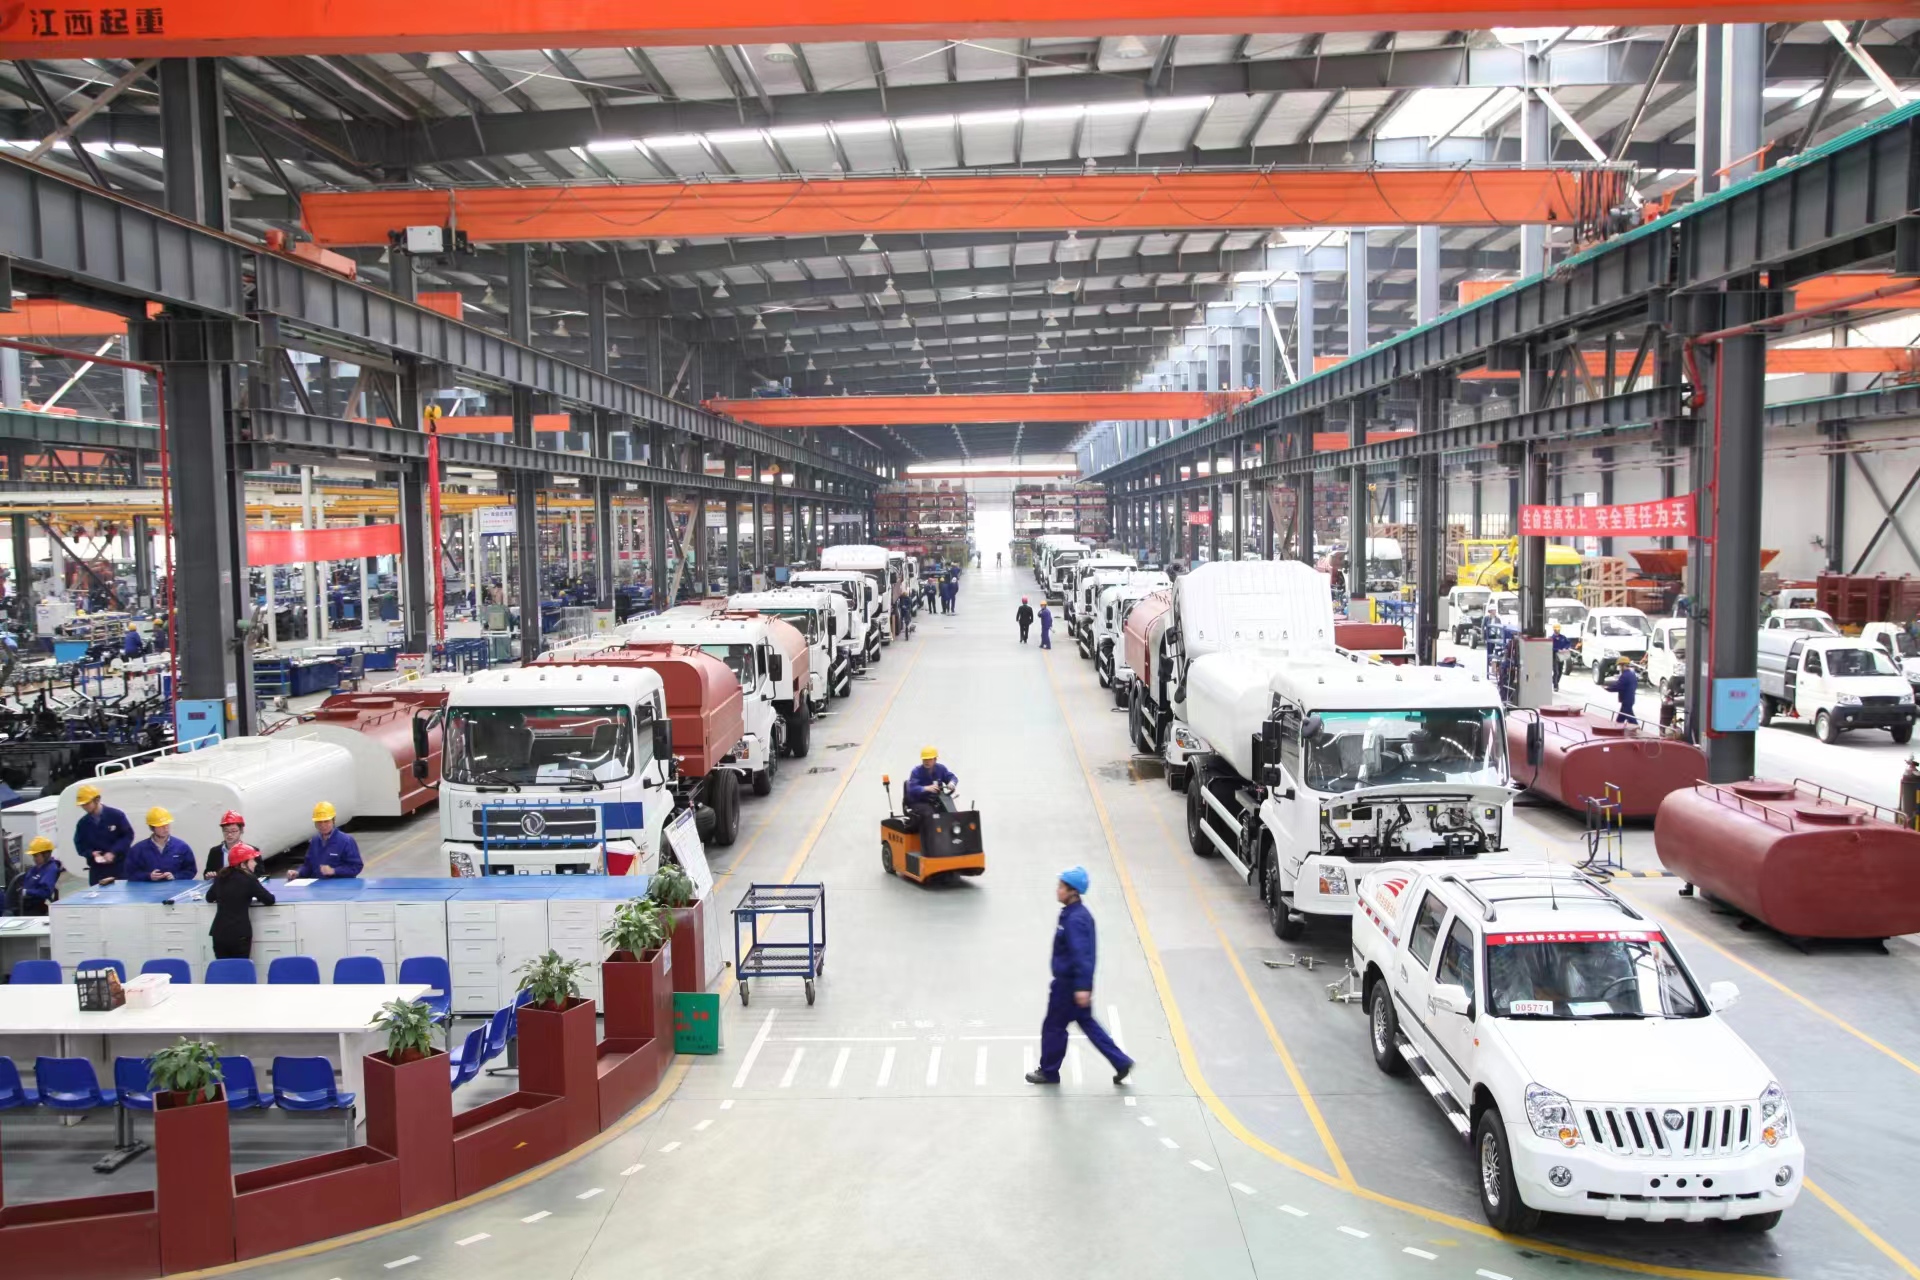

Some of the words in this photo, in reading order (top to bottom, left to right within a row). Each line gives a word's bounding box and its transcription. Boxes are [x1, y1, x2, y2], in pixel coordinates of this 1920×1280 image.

[30, 8, 164, 37] 江西起重
[1522, 508, 1588, 530] 生命至高无上
[1596, 503, 1688, 529] 安全责任为天
[1515, 1003, 1549, 1012] 005771
